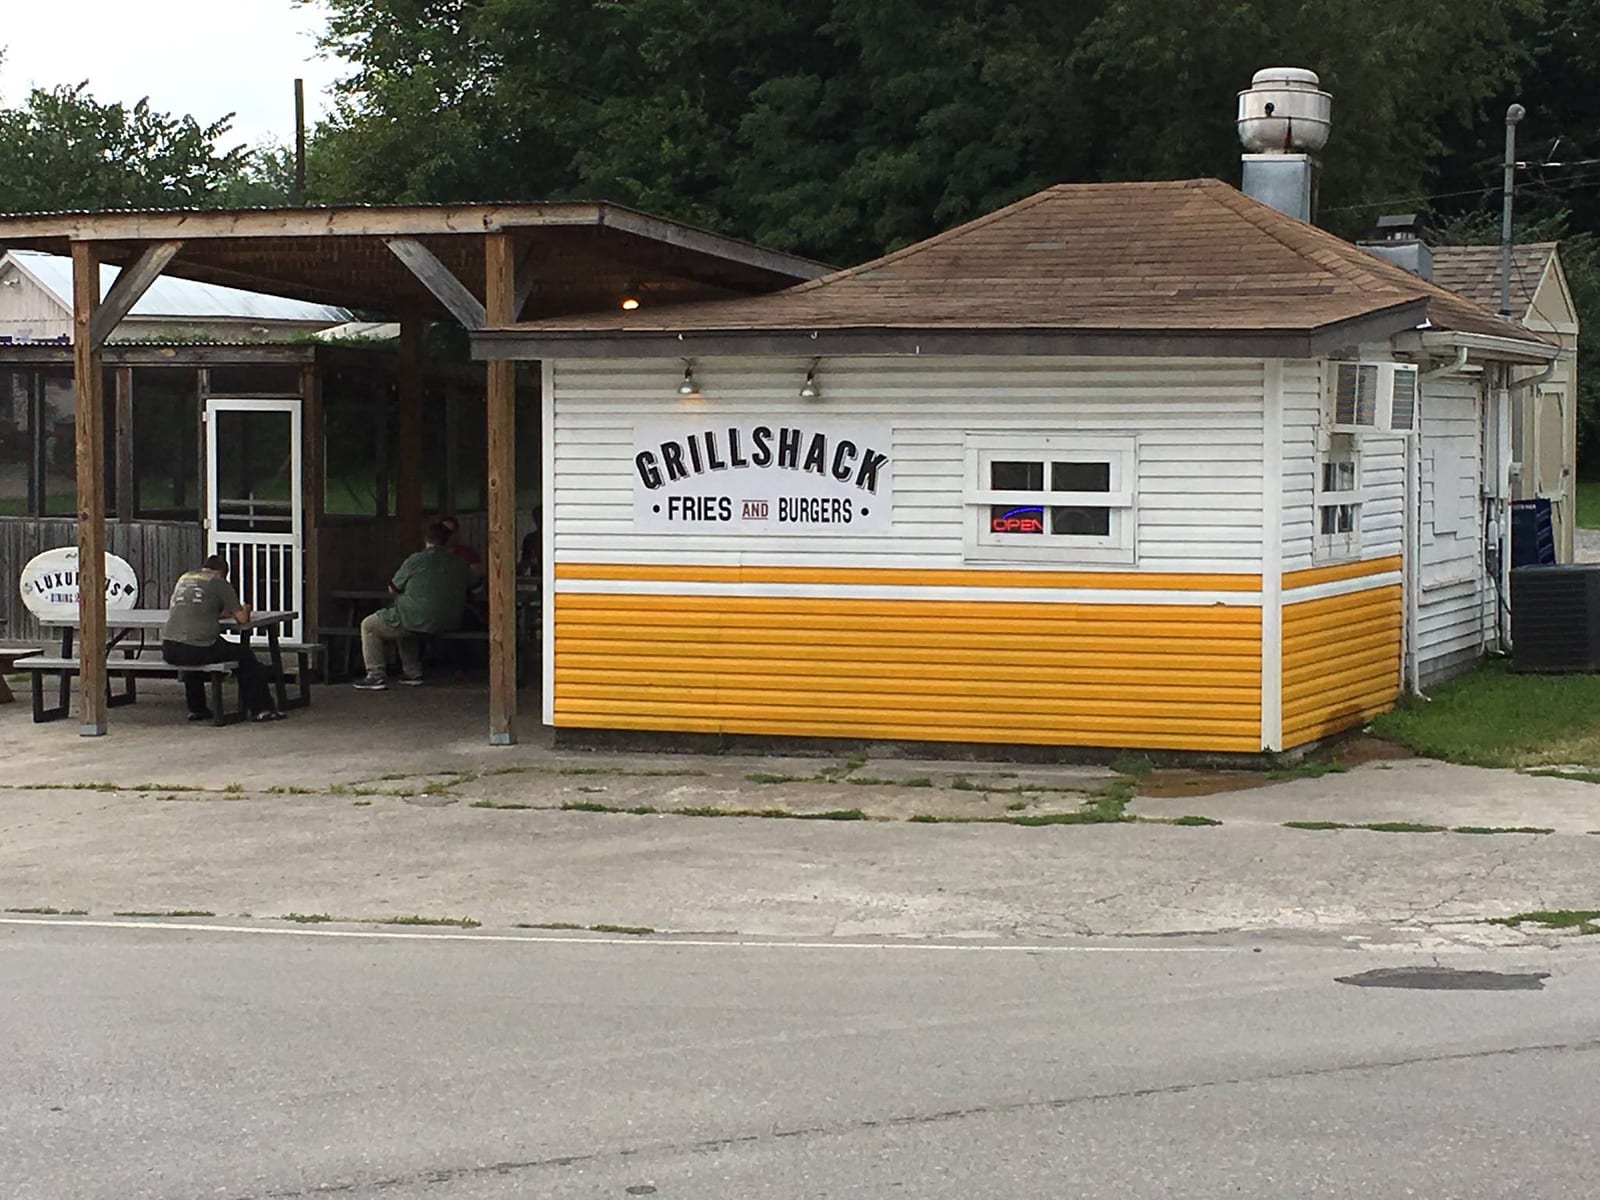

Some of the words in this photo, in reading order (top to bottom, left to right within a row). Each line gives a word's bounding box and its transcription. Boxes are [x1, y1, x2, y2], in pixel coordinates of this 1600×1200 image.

[635, 426, 889, 493] GRILLSHACK
[668, 496, 732, 521] FRIES
[741, 500, 769, 520] AND
[778, 497, 853, 523] BURGERS
[993, 518, 1042, 531] OPEN
